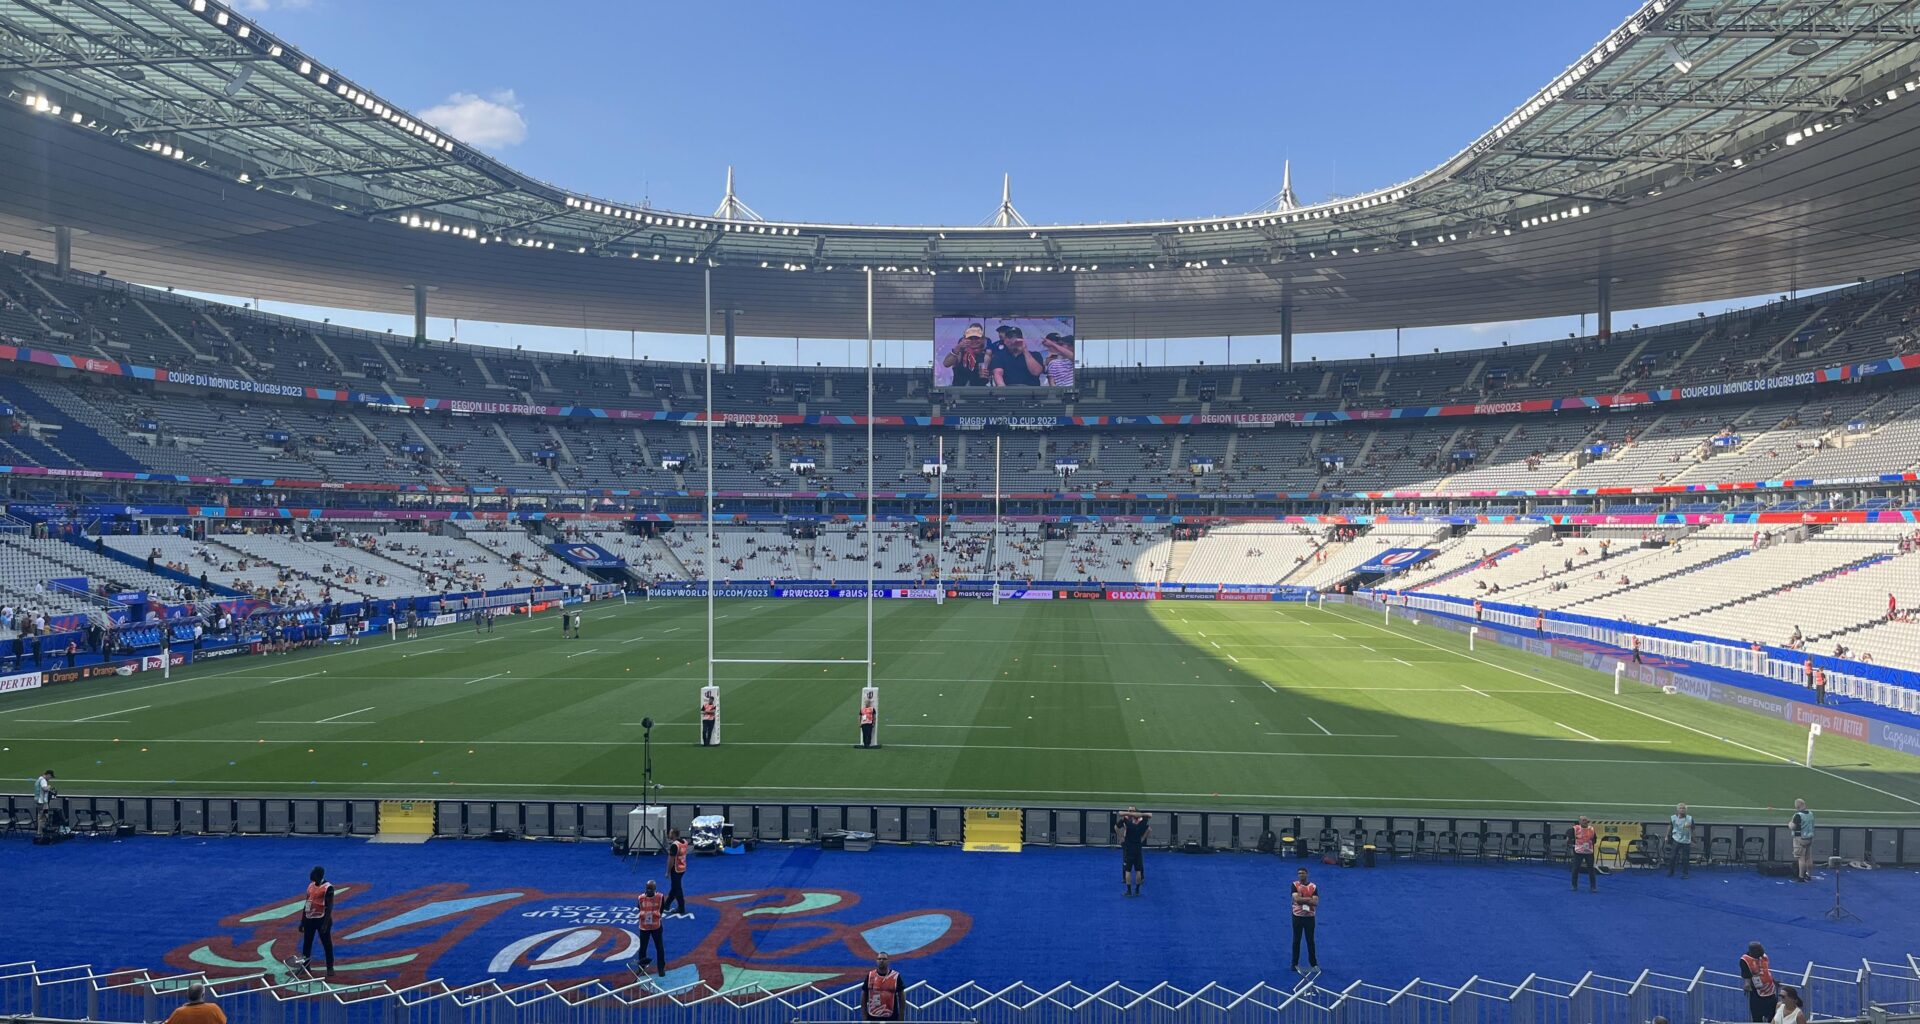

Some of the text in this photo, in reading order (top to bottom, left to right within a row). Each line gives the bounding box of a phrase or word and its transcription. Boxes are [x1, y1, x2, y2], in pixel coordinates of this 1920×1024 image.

[196, 376, 208, 387] DU
[209, 377, 240, 391] MONDE
[254, 383, 281, 396] RUGBY
[282, 386, 302, 398] 2023
[1710, 384, 1721, 396] DU
[1722, 380, 1753, 394] MONDE
[1768, 375, 1794, 389] RUGBY
[1795, 372, 1815, 386] 2023
[451, 400, 482, 410] REGION
[499, 403, 510, 413] DE
[1474, 402, 1522, 414] #RWC2023
[758, 414, 778, 424] 2023
[960, 416, 986, 426] RUGBY
[1020, 416, 1036, 425] CUP
[1038, 416, 1057, 425] 2023
[1201, 414, 1231, 423] REGION
[1248, 414, 1259, 422] DE
[649, 589, 768, 597] RUGBYWORLDUP.COM/2023
[782, 589, 829, 598] #RWC2023
[207, 648, 238, 658] DEFENDER
[148, 660, 161, 669] SNCF
[20, 676, 39, 687] TRY
[52, 672, 78, 682] Orange
[1674, 676, 1708, 697] PROMAN
[1737, 695, 1782, 713] DEFENDER
[1797, 708, 1831, 728] Emirates
[586, 911, 695, 920] WRLD
